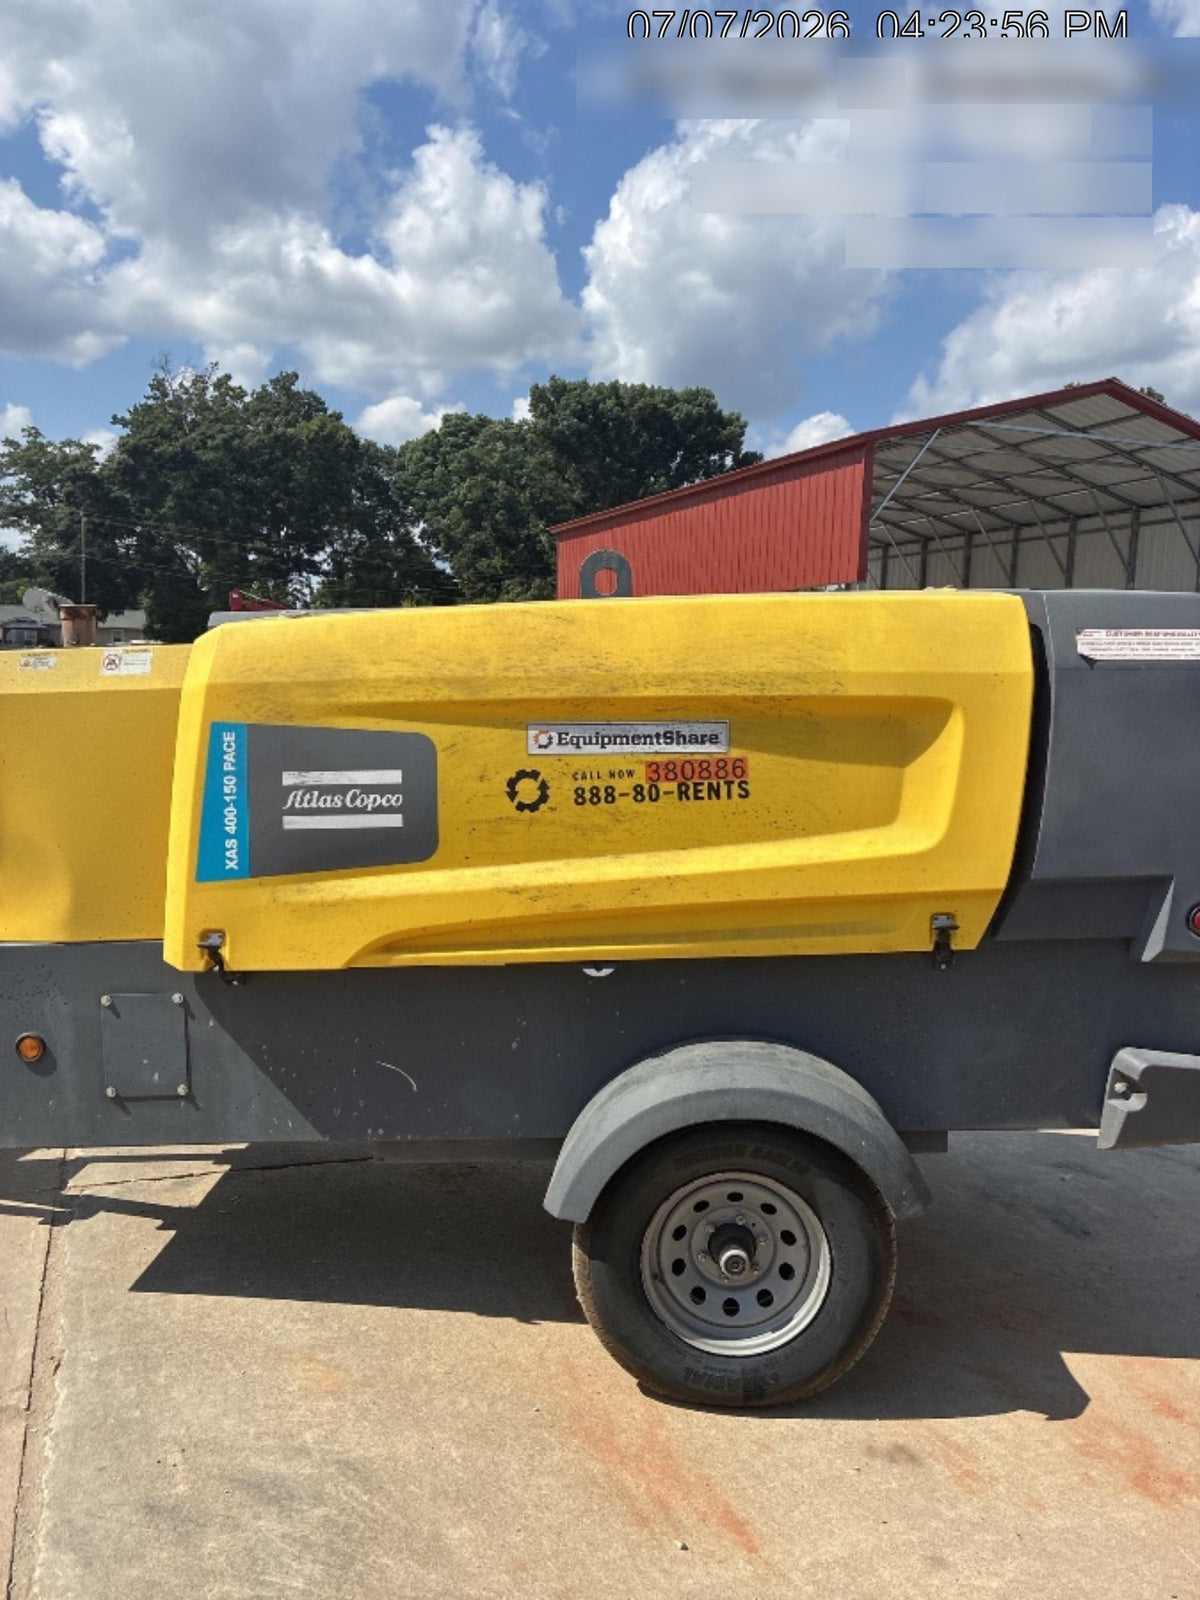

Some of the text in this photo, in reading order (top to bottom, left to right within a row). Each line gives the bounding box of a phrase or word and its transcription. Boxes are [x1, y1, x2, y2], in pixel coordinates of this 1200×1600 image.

[556, 730, 720, 749] EquipmentShare
[572, 769, 635, 781] CALL NOW
[647, 758, 746, 783] 380886
[222, 731, 239, 871] XAS 400-150 PACE
[282, 788, 403, 812] Atlas Copco
[573, 781, 750, 806] 888-80-RENTS
